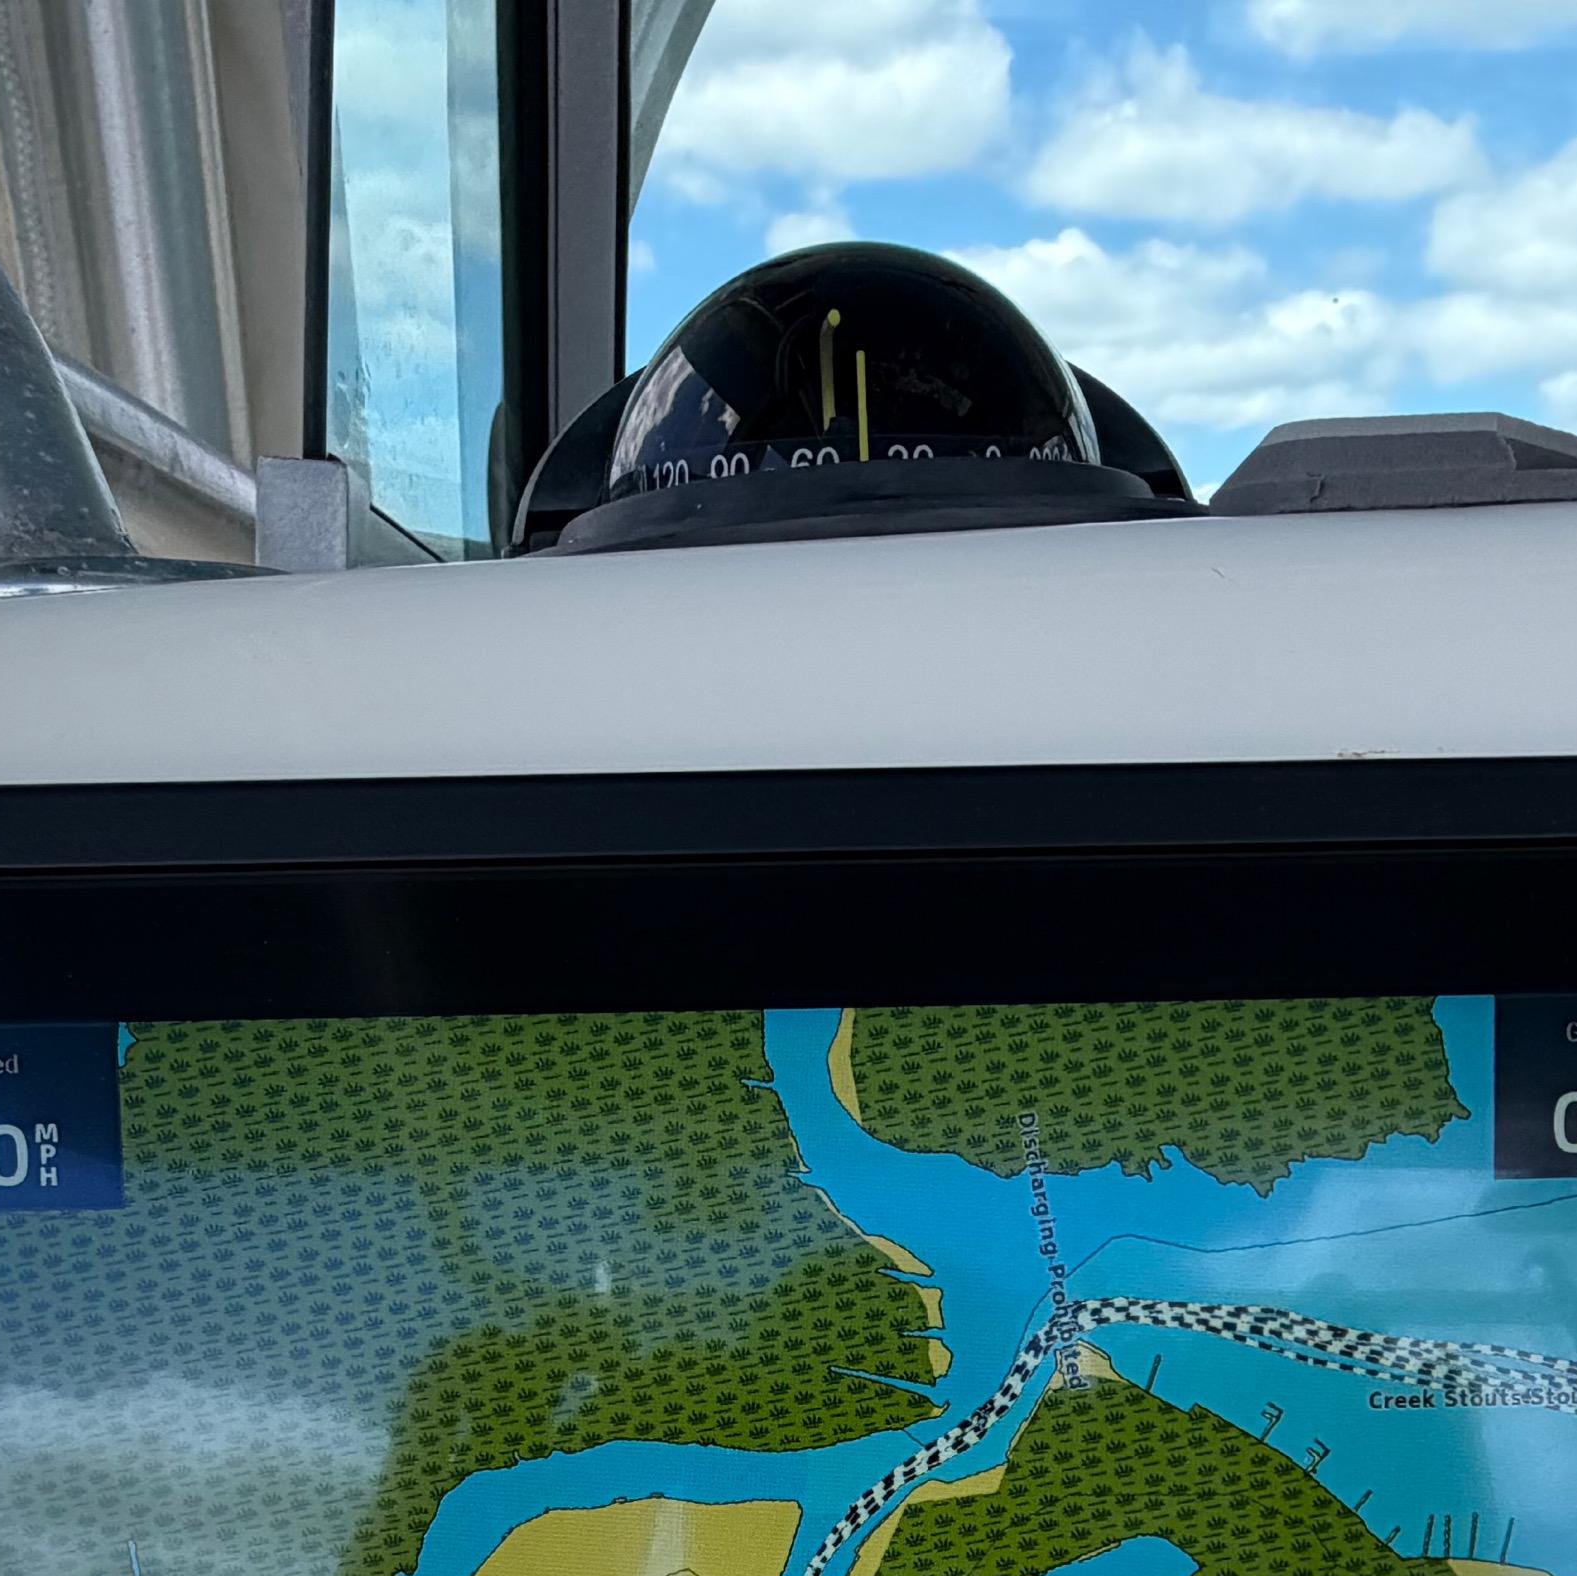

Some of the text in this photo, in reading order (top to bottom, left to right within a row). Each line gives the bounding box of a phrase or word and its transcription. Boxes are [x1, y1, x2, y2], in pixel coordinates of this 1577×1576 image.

[1016, 1111, 1090, 1390] Discharging Prohibited
[1368, 1386, 1437, 1410] Creek
[1444, 1383, 1523, 1408] Stouts
